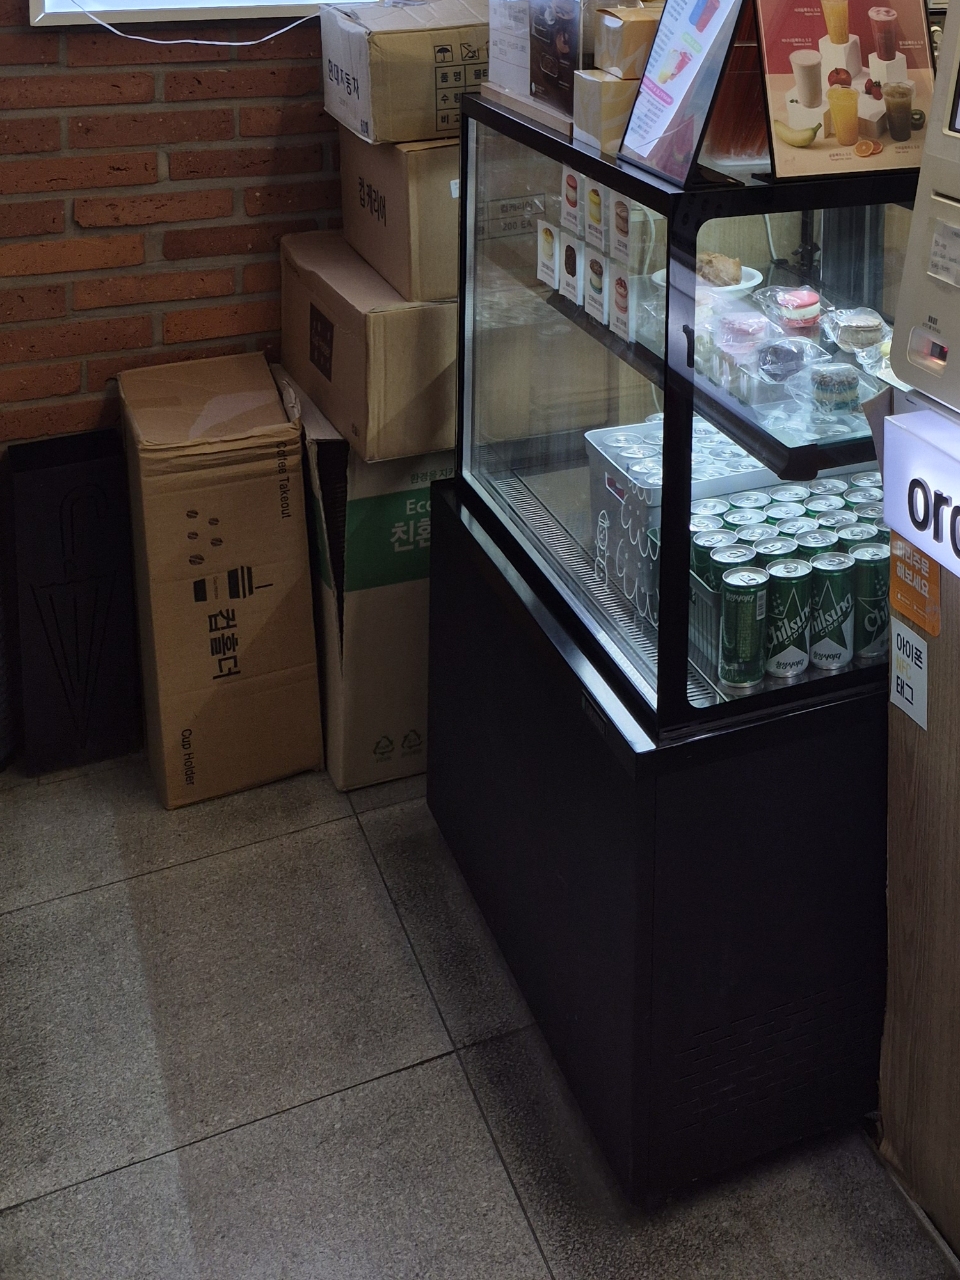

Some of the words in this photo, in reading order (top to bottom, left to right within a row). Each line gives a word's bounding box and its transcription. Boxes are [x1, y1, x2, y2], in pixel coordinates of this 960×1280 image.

[502, 222, 517, 231] 200
[521, 220, 533, 229] EA
[276, 441, 287, 475] Coffee
[279, 476, 292, 519] Takeout
[896, 561, 929, 599] 해보세요
[820, 616, 844, 636] CIDER
[207, 608, 241, 680] 컵홀더
[813, 650, 842, 661] 칠성사이다
[896, 632, 923, 670] 아이폰
[775, 658, 804, 670] 칠성사이다
[896, 655, 912, 681] NFC
[896, 675, 914, 706] 태그
[181, 728, 193, 751] Cup
[182, 752, 197, 786] Holder
